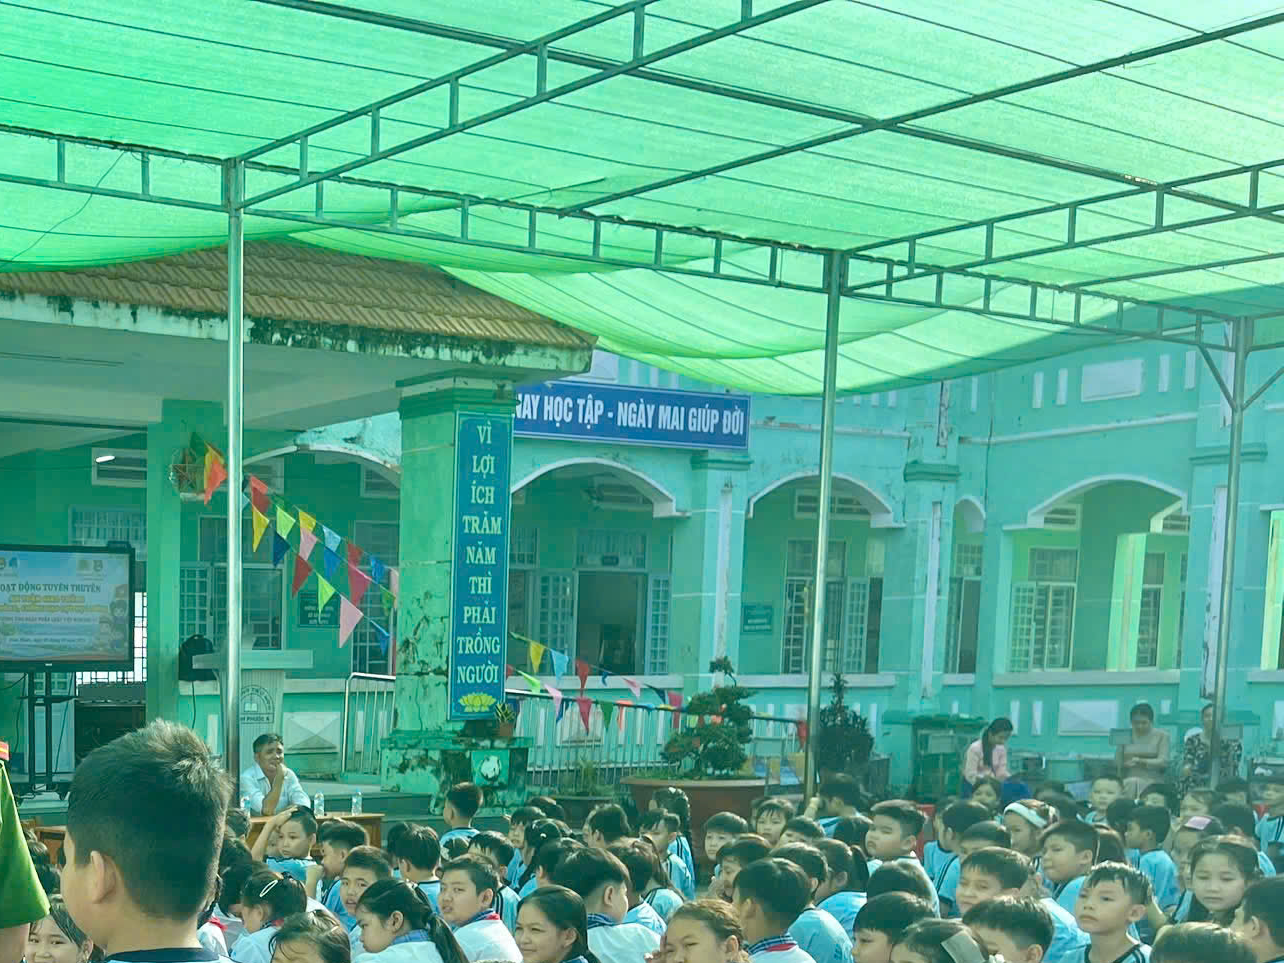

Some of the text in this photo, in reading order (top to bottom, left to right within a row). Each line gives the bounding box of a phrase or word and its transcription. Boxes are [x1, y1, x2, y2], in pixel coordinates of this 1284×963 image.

[543, 395, 573, 428] HỌC
[577, 393, 604, 430] TẬP
[617, 398, 655, 429] NGÀY
[658, 404, 685, 431] MAI
[688, 403, 720, 433] GIÚP
[722, 405, 745, 436] ĐỜI
[476, 420, 492, 444] VÌ
[472, 454, 495, 479] LỢI
[470, 480, 495, 505] ÍCH
[462, 511, 502, 535] TRĂM
[466, 541, 497, 565] NĂM
[469, 571, 493, 595] THÌ
[463, 600, 497, 625] PHẢI
[456, 626, 501, 655] TRỒNG
[456, 660, 499, 684] NGƯỜI
